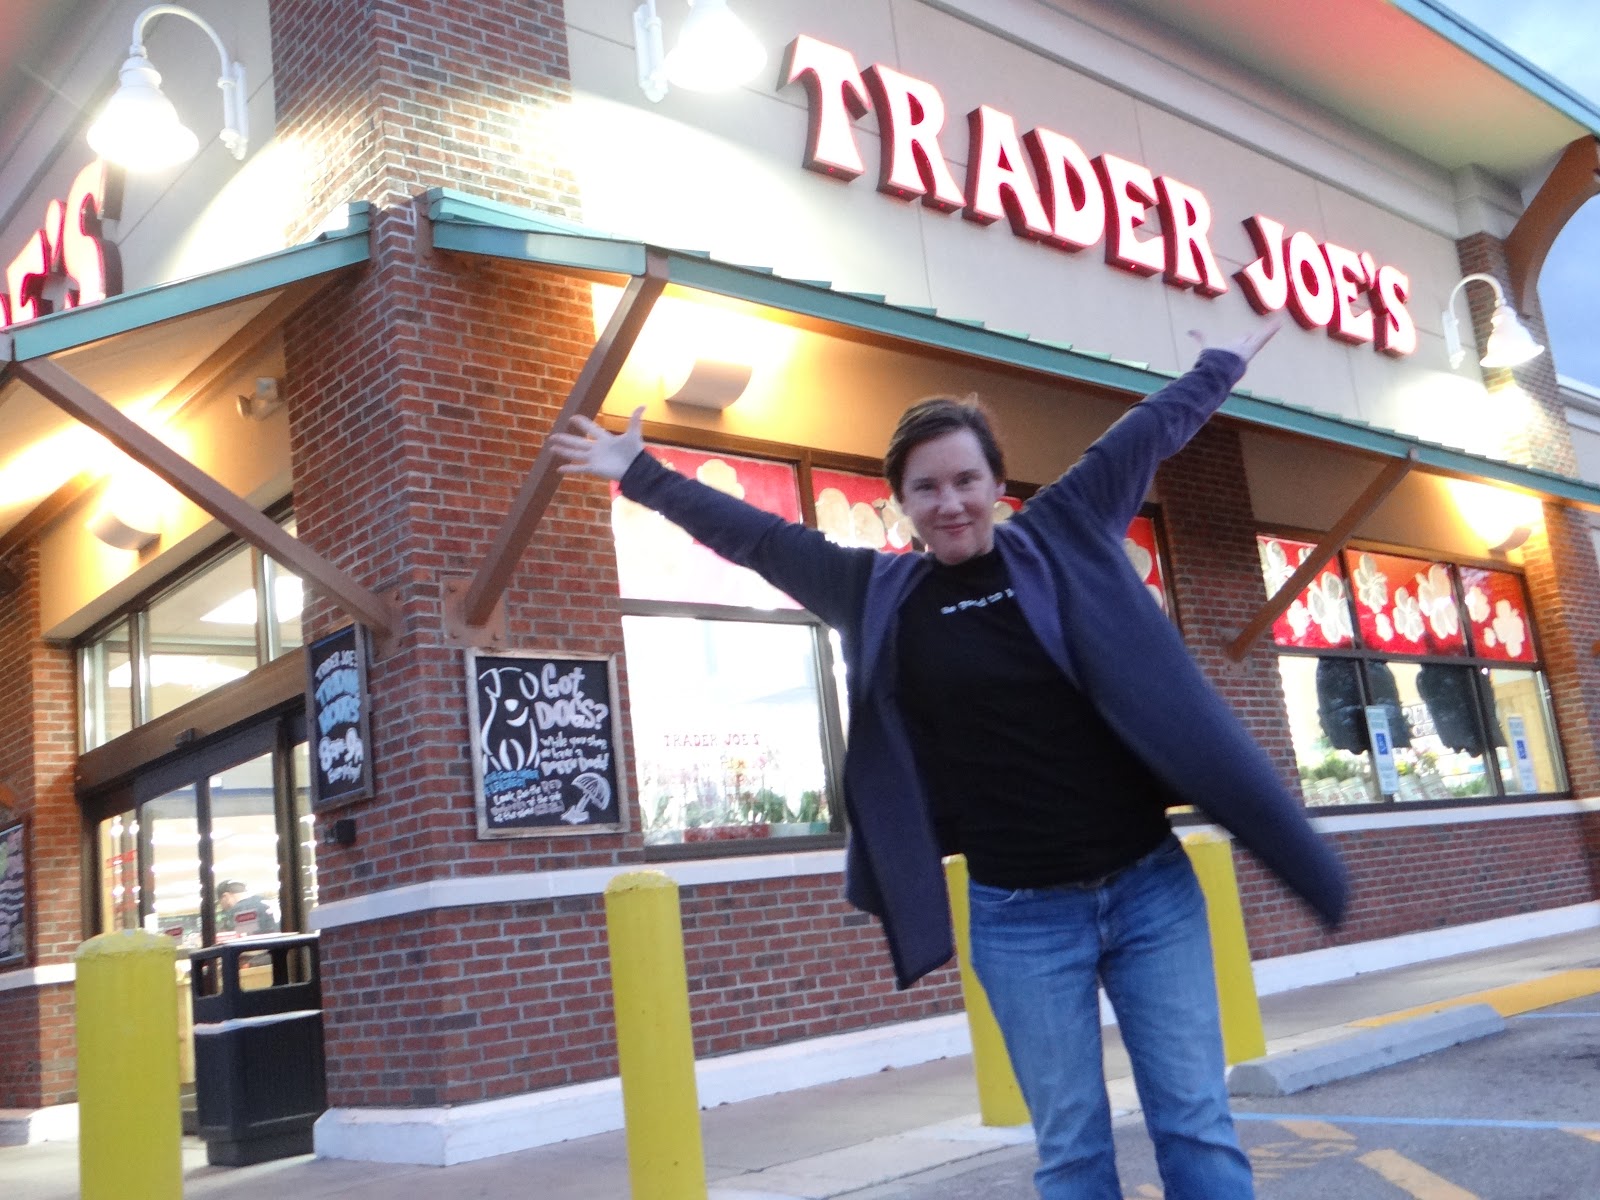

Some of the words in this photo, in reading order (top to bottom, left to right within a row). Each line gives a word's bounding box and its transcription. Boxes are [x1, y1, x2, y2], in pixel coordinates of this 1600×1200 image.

[780, 35, 1228, 298] TRADER
[1235, 215, 1418, 358] JOE'S
[541, 662, 585, 699] Got
[534, 697, 609, 730] DOGS?
[663, 734, 717, 747] TRADER
[724, 733, 760, 746] JOES
